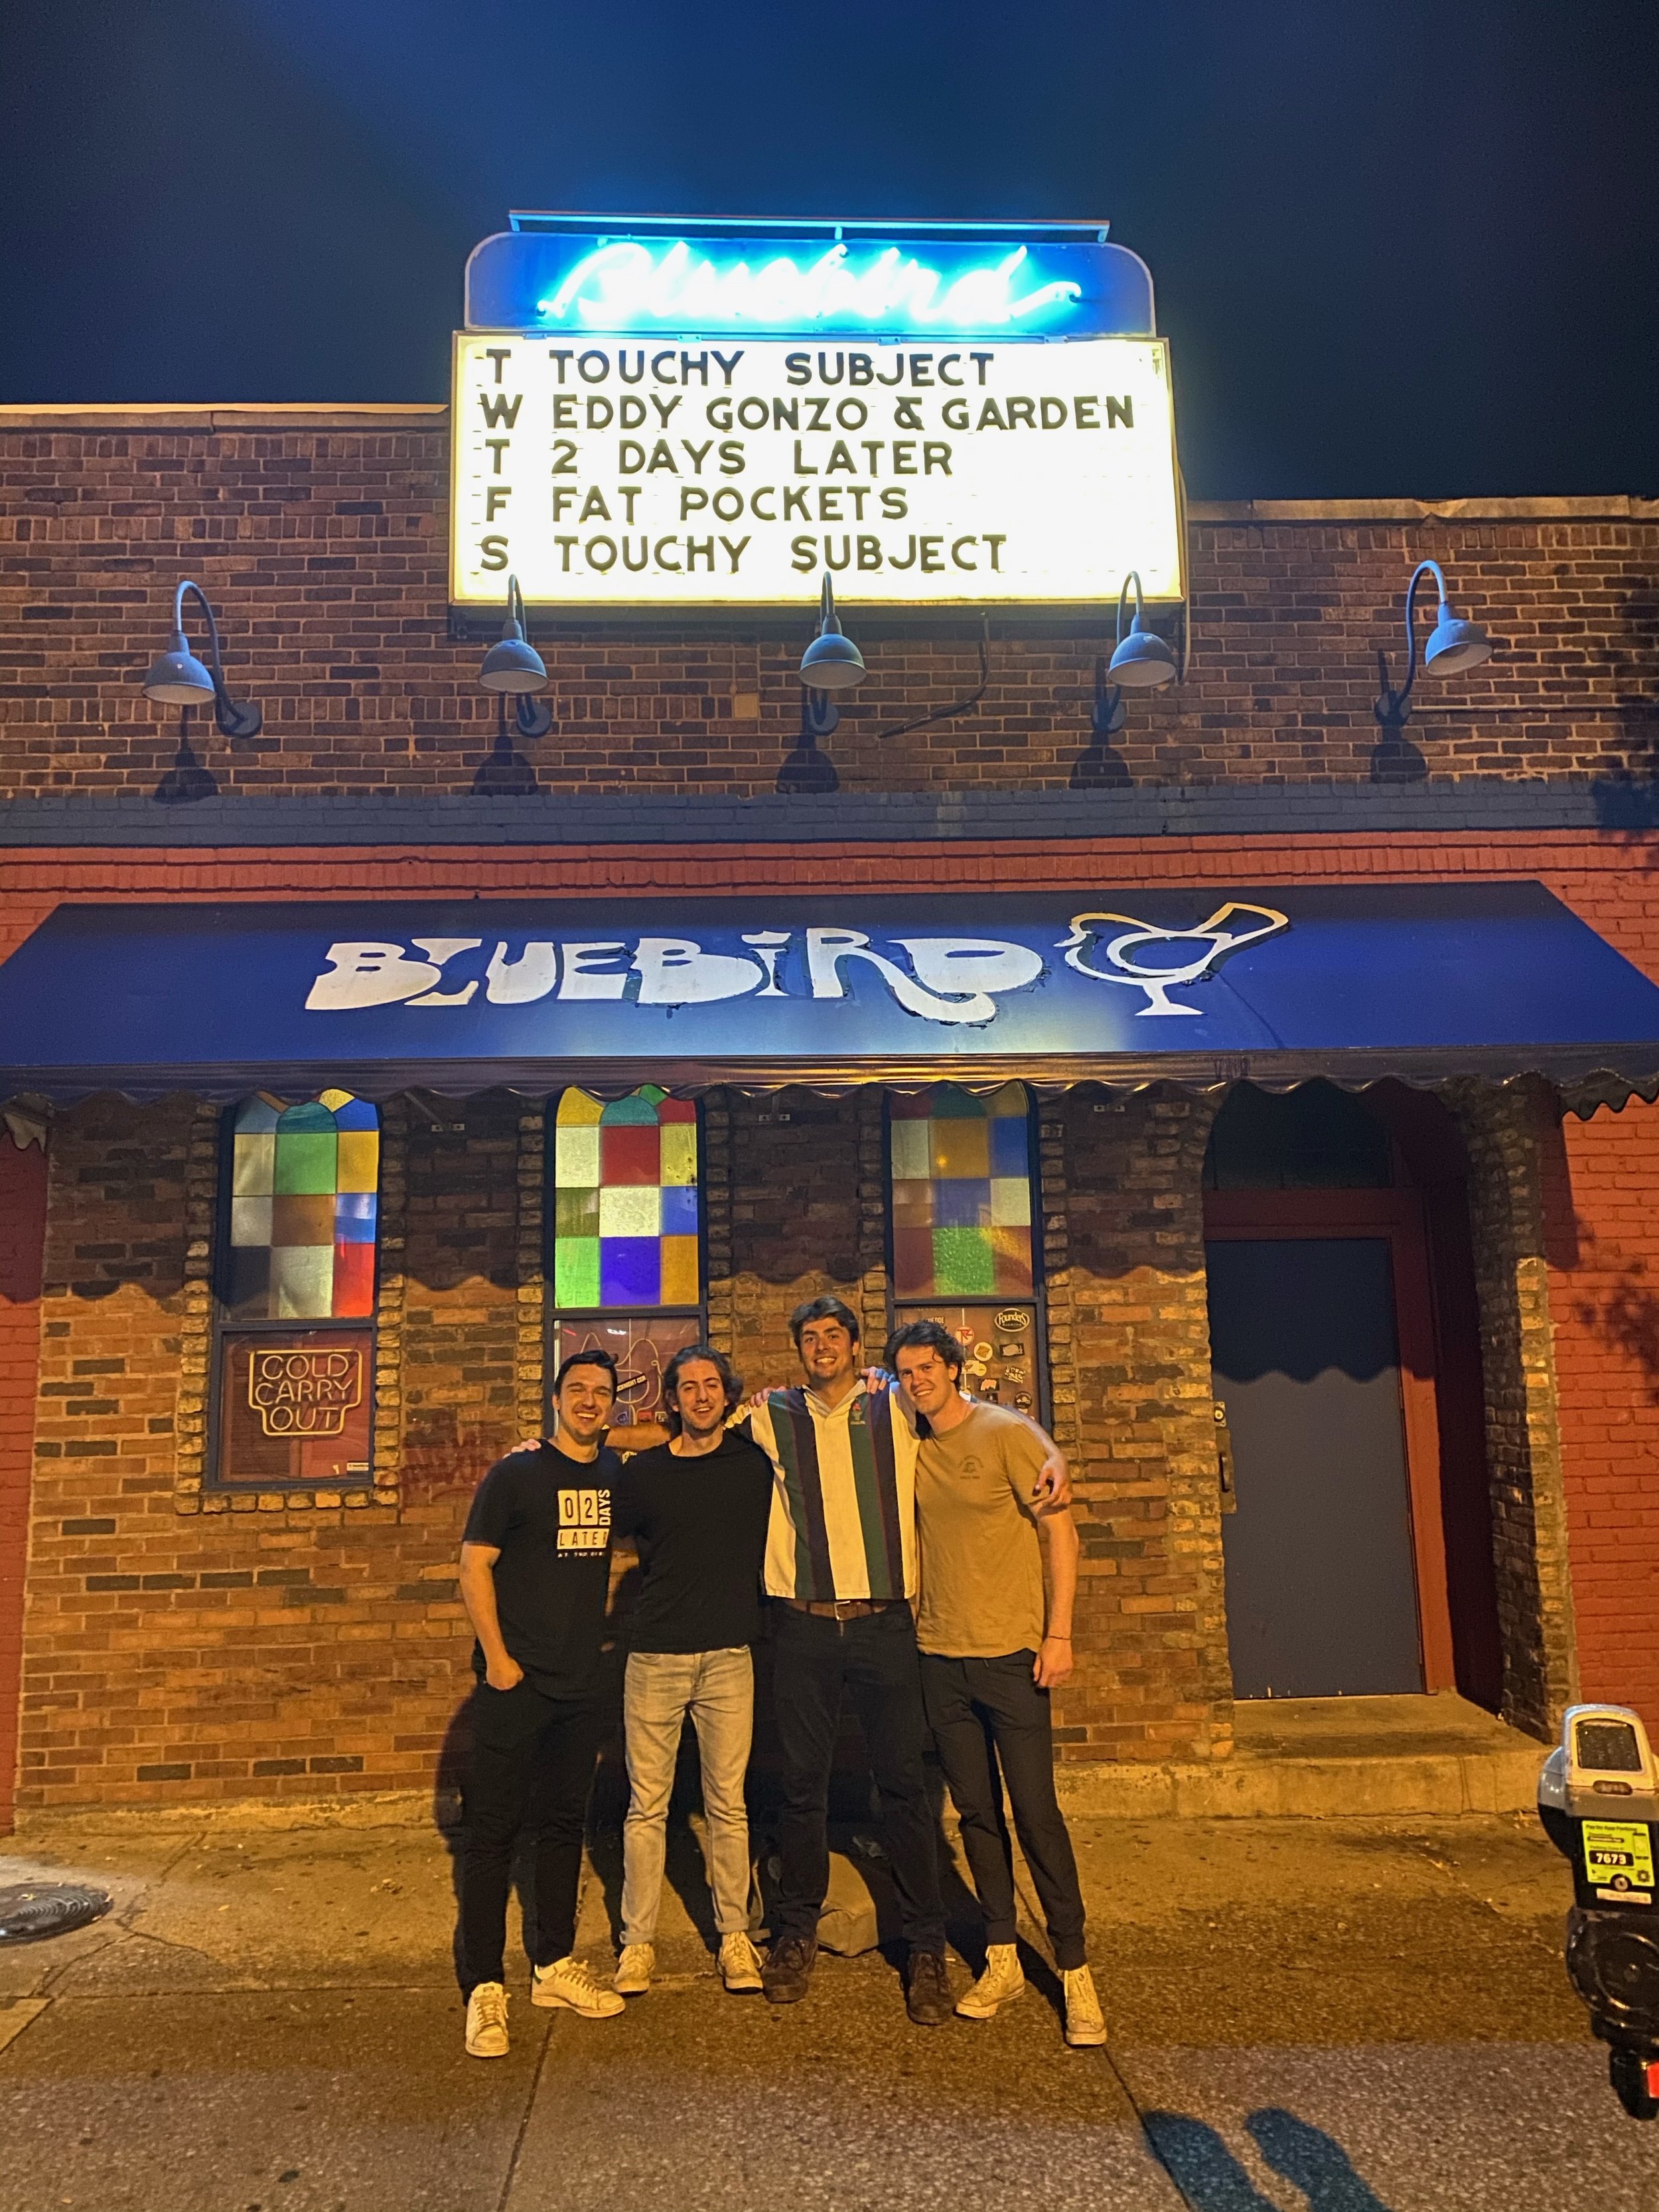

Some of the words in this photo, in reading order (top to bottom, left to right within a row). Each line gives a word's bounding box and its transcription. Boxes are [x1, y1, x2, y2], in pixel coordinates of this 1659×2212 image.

[486, 348, 511, 383] T
[549, 350, 745, 386] TOUCHY
[785, 352, 994, 387] SUBJECT
[479, 394, 523, 429] W
[553, 394, 682, 429] EDDY
[706, 397, 868, 431] GONZO
[894, 396, 924, 430] &
[942, 396, 1133, 431] GARDEN
[485, 441, 510, 474] T
[552, 441, 577, 473] 2
[619, 440, 745, 475] DAYS
[794, 440, 952, 475] LATER
[486, 489, 512, 522] F
[553, 488, 642, 523] FAT
[680, 486, 907, 522] POCKETS
[480, 538, 508, 571] S
[555, 536, 751, 573] TOUCHY
[791, 536, 1005, 572] SUBJECT
[261, 1354, 349, 1380] COLD
[255, 1379, 353, 1406] CARRY
[269, 1406, 339, 1431] OUT
[597, 1489, 611, 1526] DAYS
[1596, 1852, 1626, 1865] 7673
